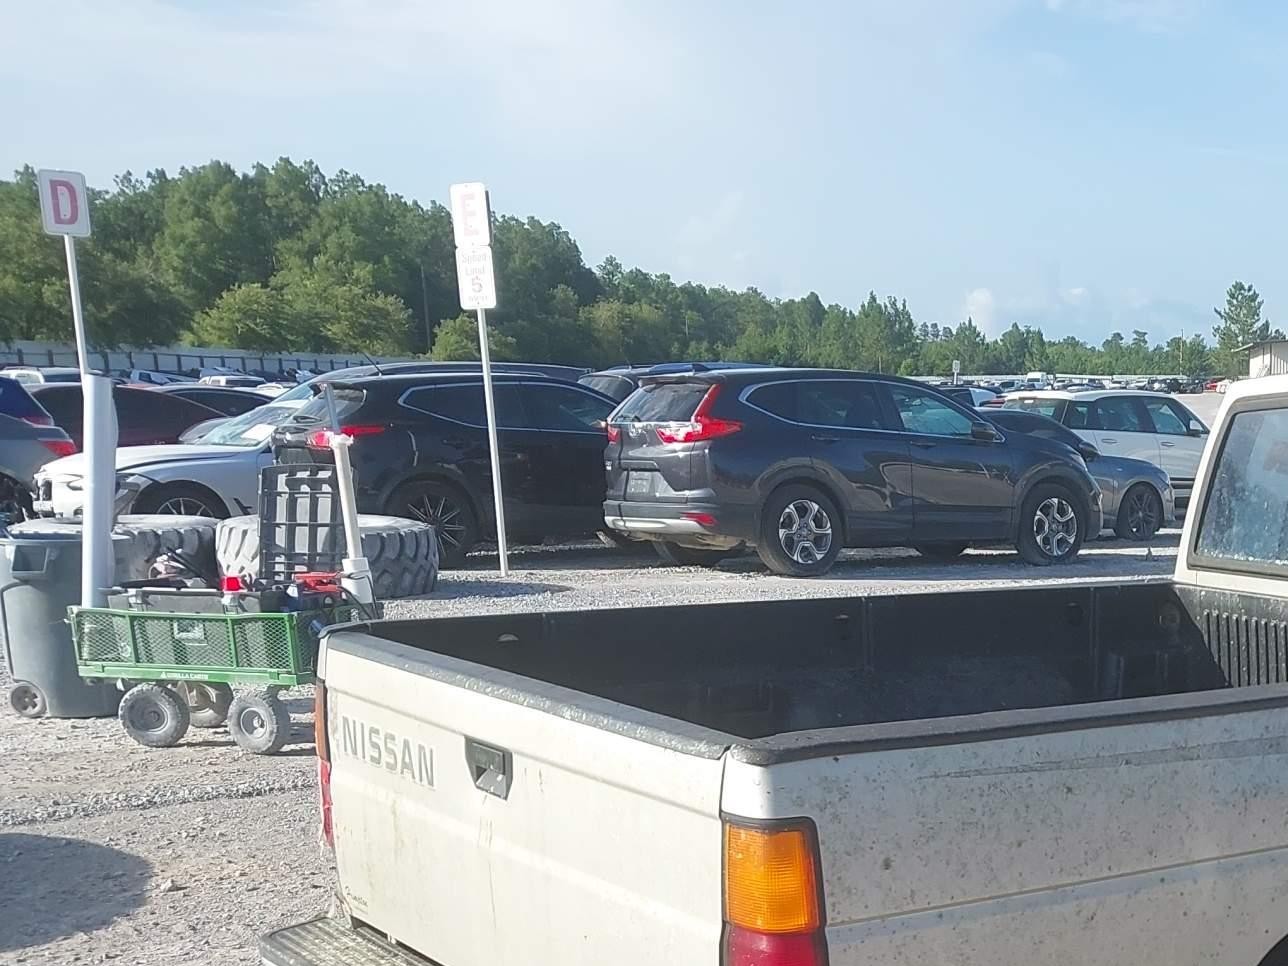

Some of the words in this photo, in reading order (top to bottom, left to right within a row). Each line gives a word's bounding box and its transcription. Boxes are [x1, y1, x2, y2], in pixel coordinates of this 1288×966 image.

[49, 179, 79, 225] D
[461, 193, 480, 237] E
[471, 277, 483, 293] 5
[341, 715, 436, 788] NISSAN
